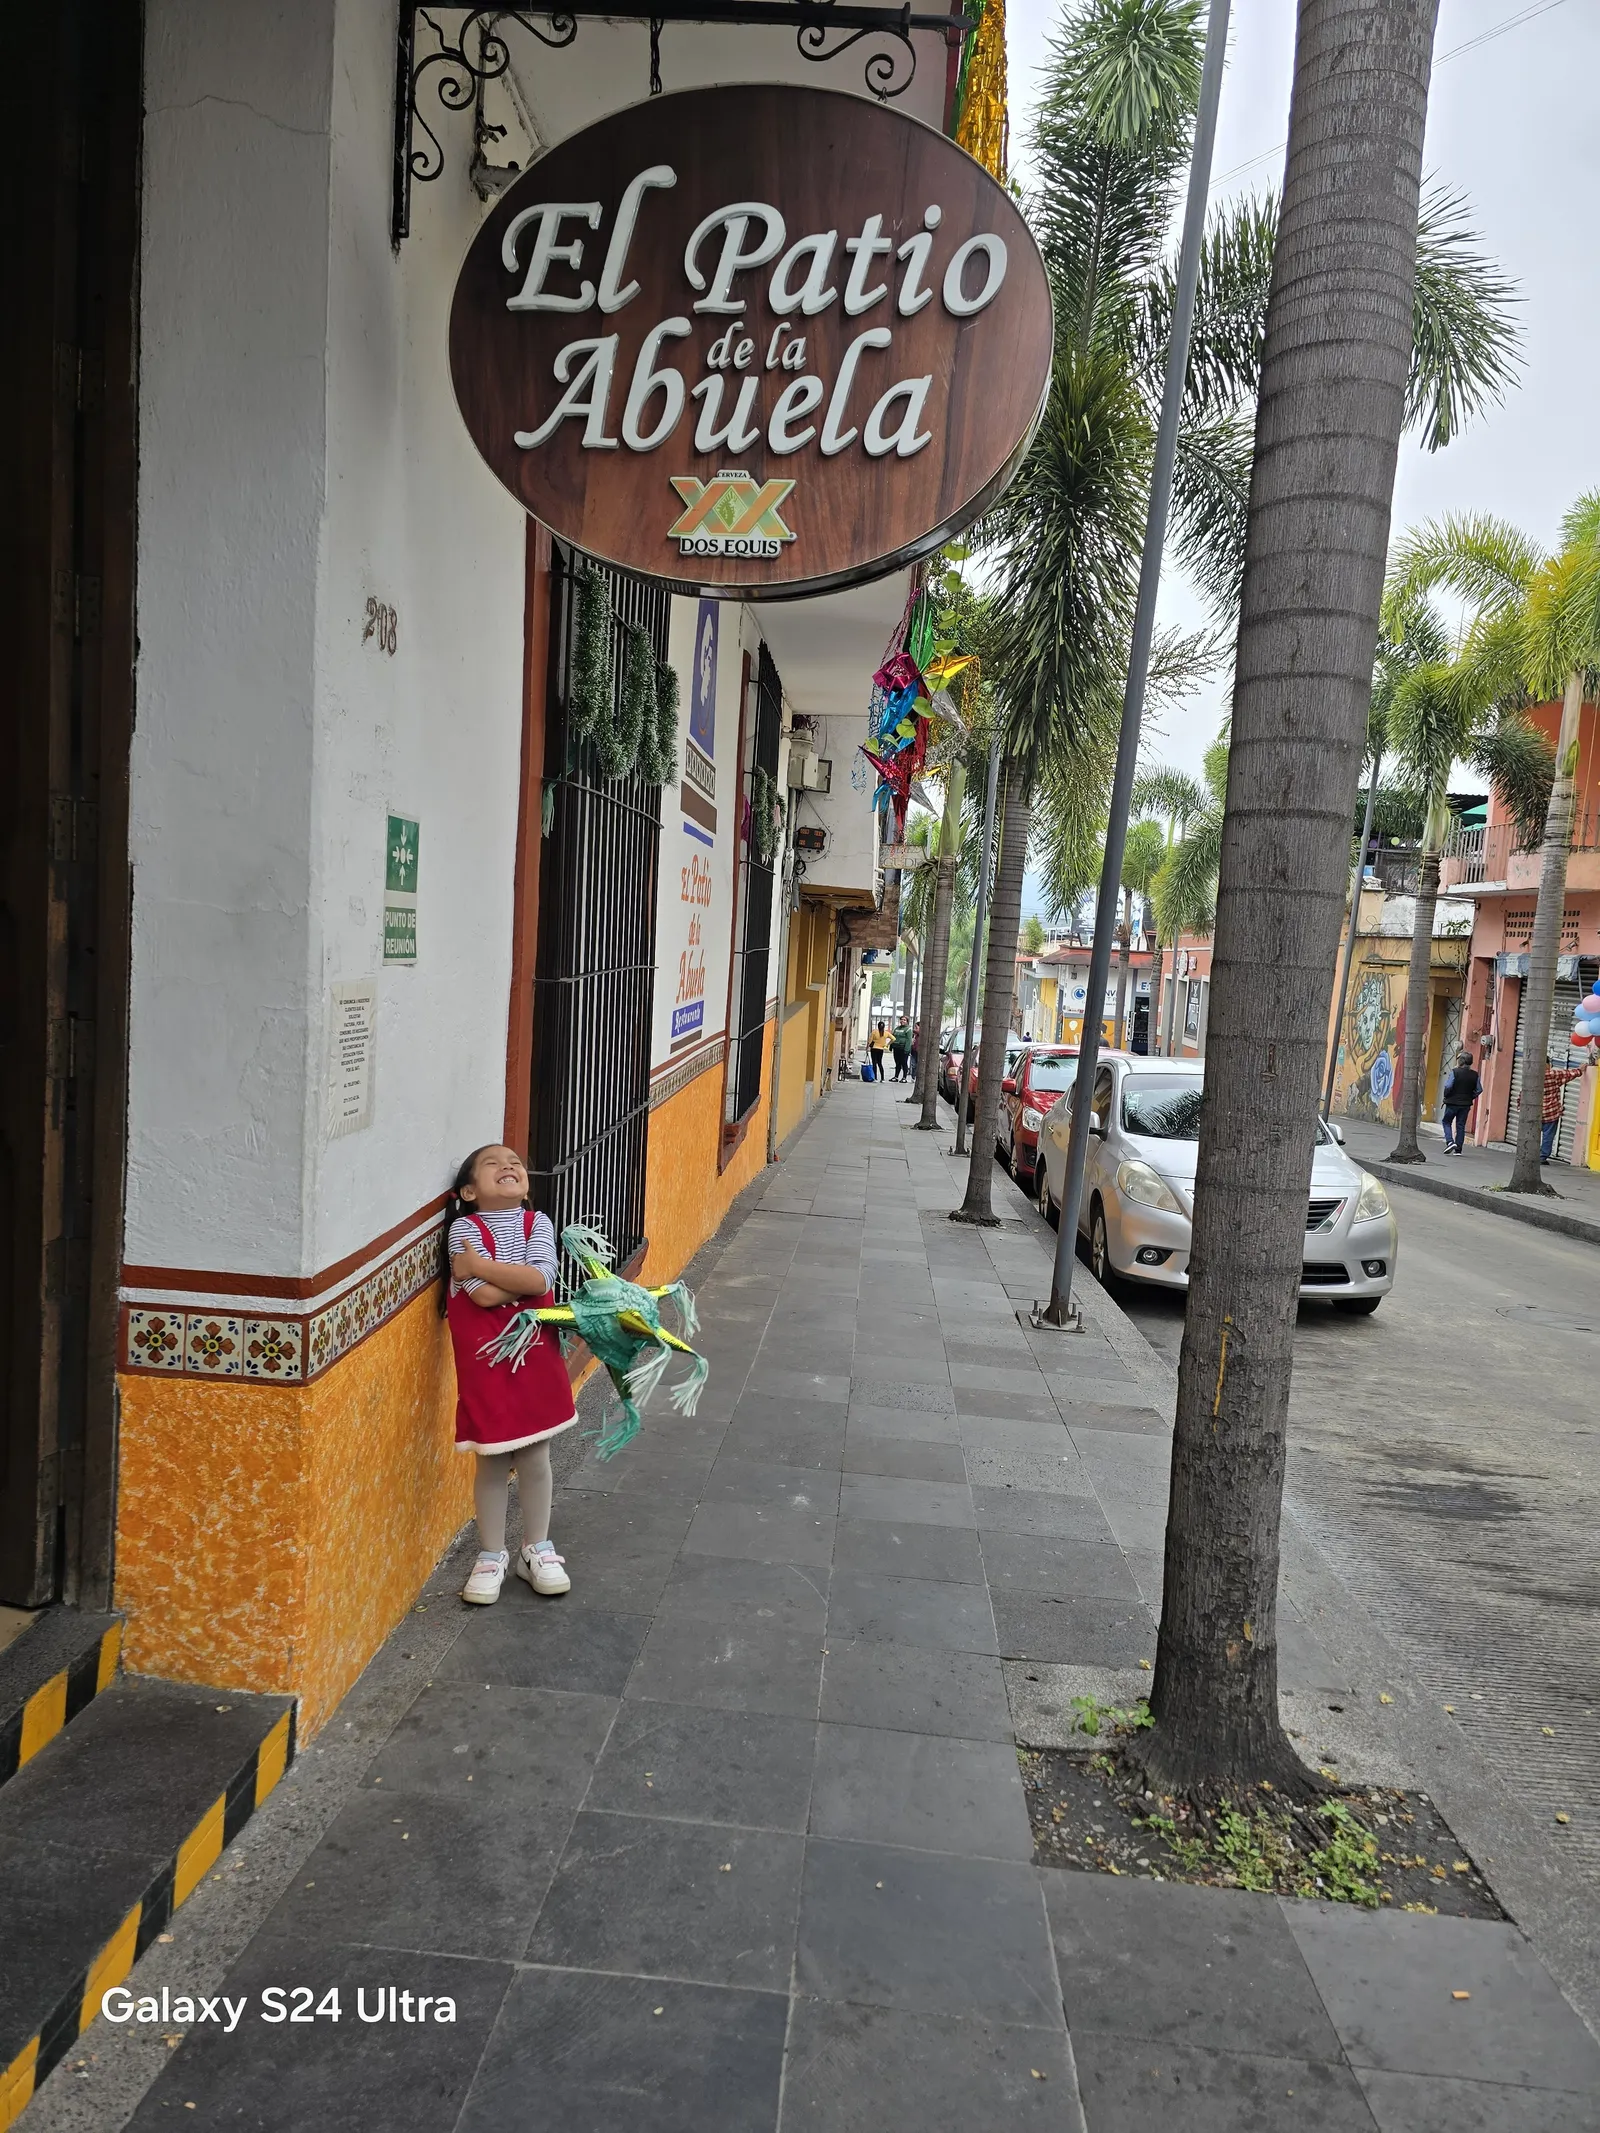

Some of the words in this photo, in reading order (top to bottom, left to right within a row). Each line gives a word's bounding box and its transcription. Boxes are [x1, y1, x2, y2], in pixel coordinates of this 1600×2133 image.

[501, 164, 677, 314] El
[684, 201, 1008, 317] Patio
[706, 321, 755, 370] de
[765, 321, 807, 371] la
[514, 316, 934, 456] Abuela
[717, 470, 747, 478] CERVEZA
[681, 538, 718, 553] DOS
[724, 539, 778, 555] EQUIS
[363, 594, 397, 655] 208
[688, 854, 712, 907] Patio
[385, 911, 406, 928] PUNTO
[407, 913, 416, 928] DE
[385, 935, 415, 954] REUNIÓN
